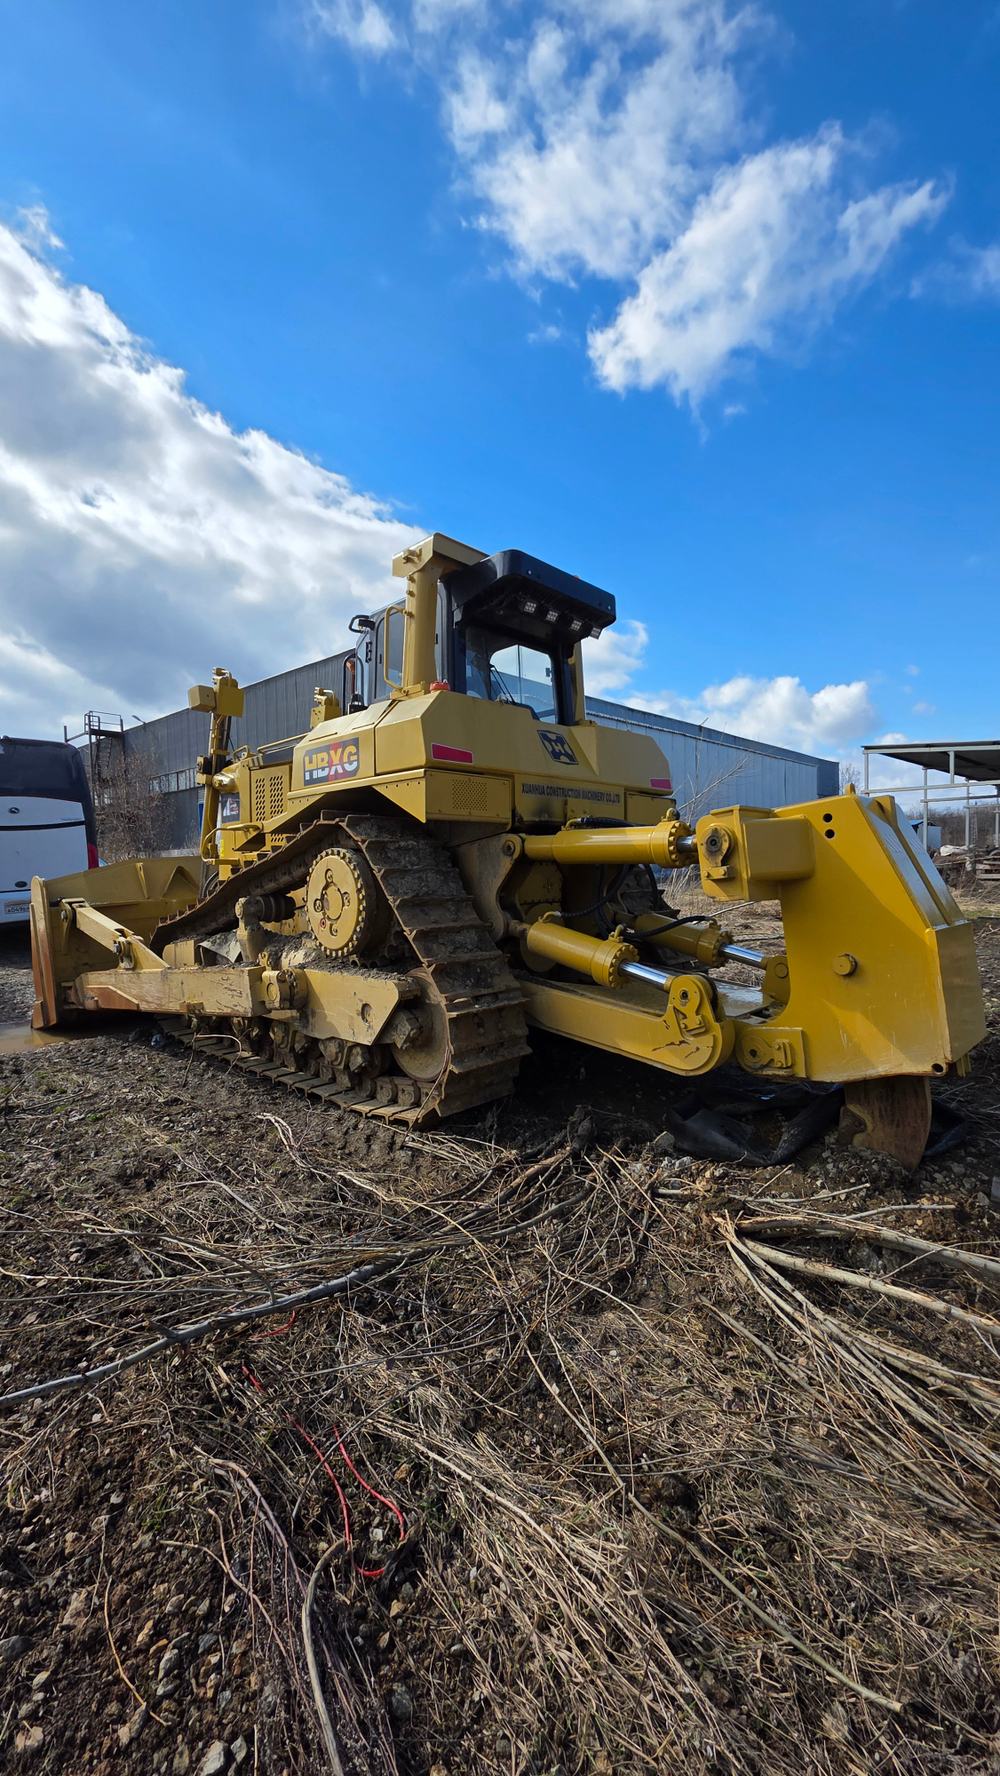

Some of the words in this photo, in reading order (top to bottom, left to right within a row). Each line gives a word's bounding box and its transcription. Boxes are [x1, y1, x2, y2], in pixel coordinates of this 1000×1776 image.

[305, 745, 358, 780] HBXG
[522, 783, 545, 796] XUANHUA
[546, 785, 581, 799] CONSTRUCTION
[581, 788, 605, 802] MACHINERY
